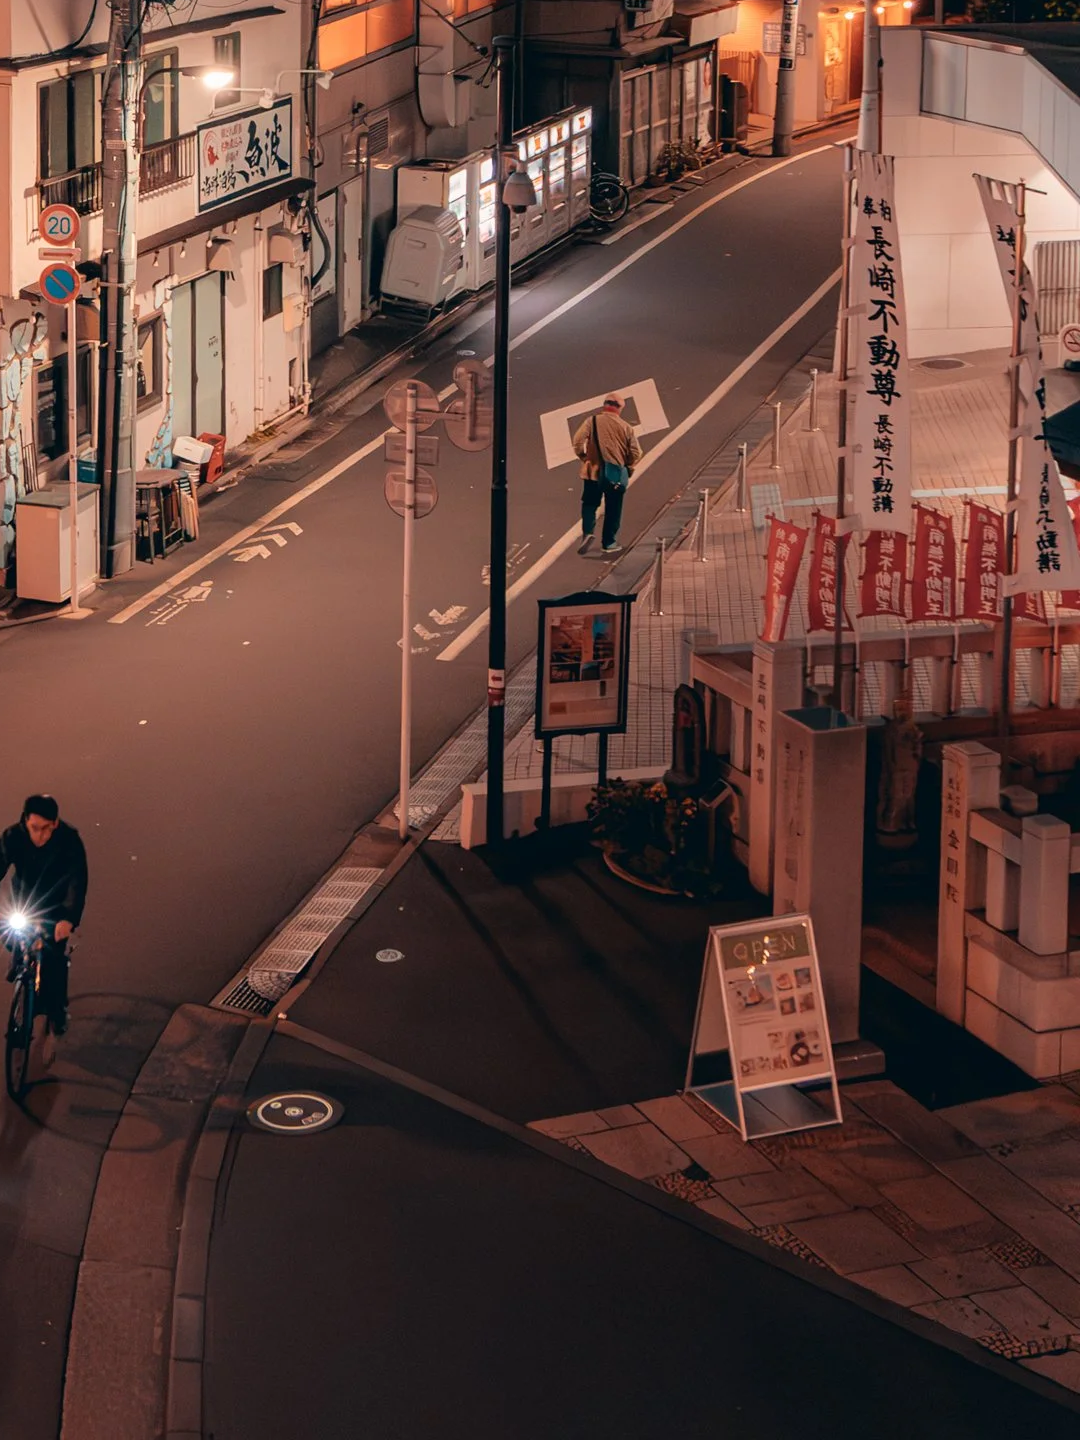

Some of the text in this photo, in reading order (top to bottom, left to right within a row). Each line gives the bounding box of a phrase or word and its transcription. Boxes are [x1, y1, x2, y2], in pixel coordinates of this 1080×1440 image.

[47, 216, 71, 235] 20
[865, 225, 902, 407] 長崎不動尊
[871, 414, 896, 513] 長崎不動講
[733, 934, 796, 960] OPEN
